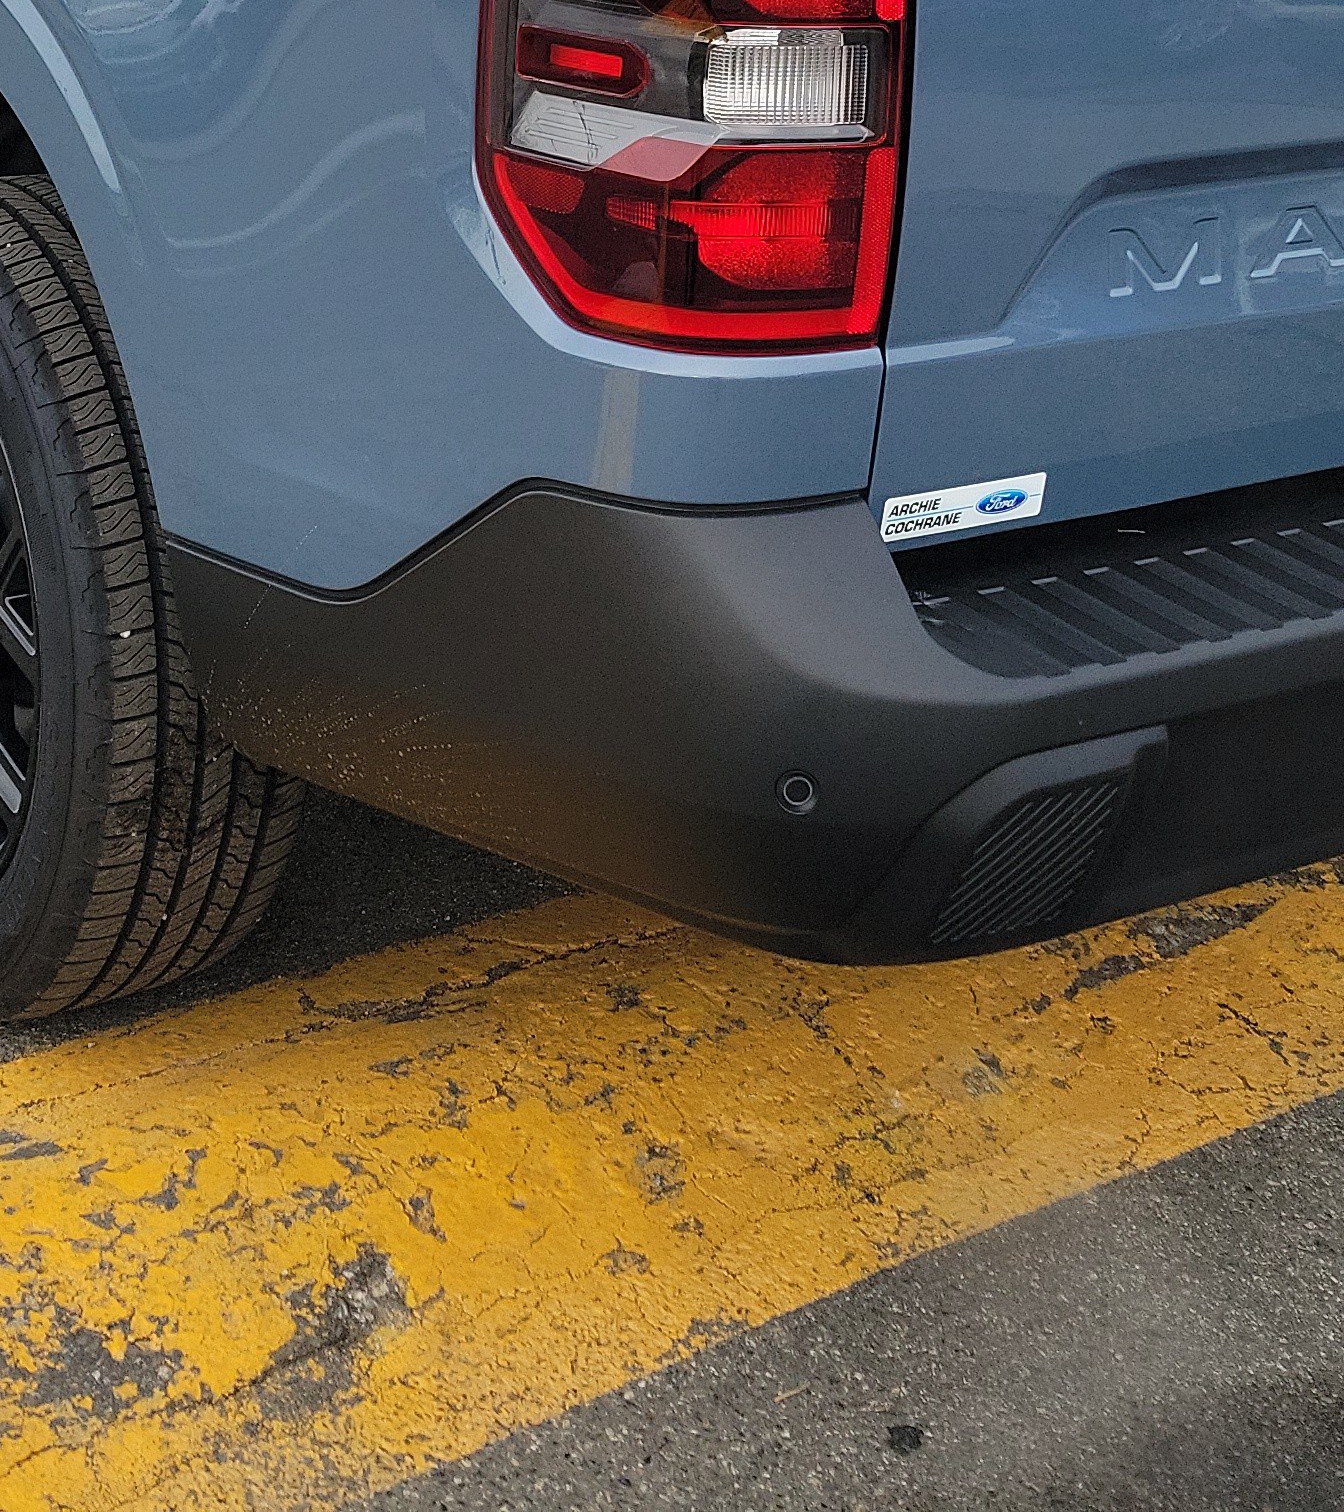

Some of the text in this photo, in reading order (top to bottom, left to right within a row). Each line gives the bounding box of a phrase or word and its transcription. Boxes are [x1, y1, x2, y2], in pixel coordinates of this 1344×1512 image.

[888, 497, 942, 518] ARCHIE
[985, 492, 1021, 512] Ford
[884, 511, 962, 536] COCHRANE
